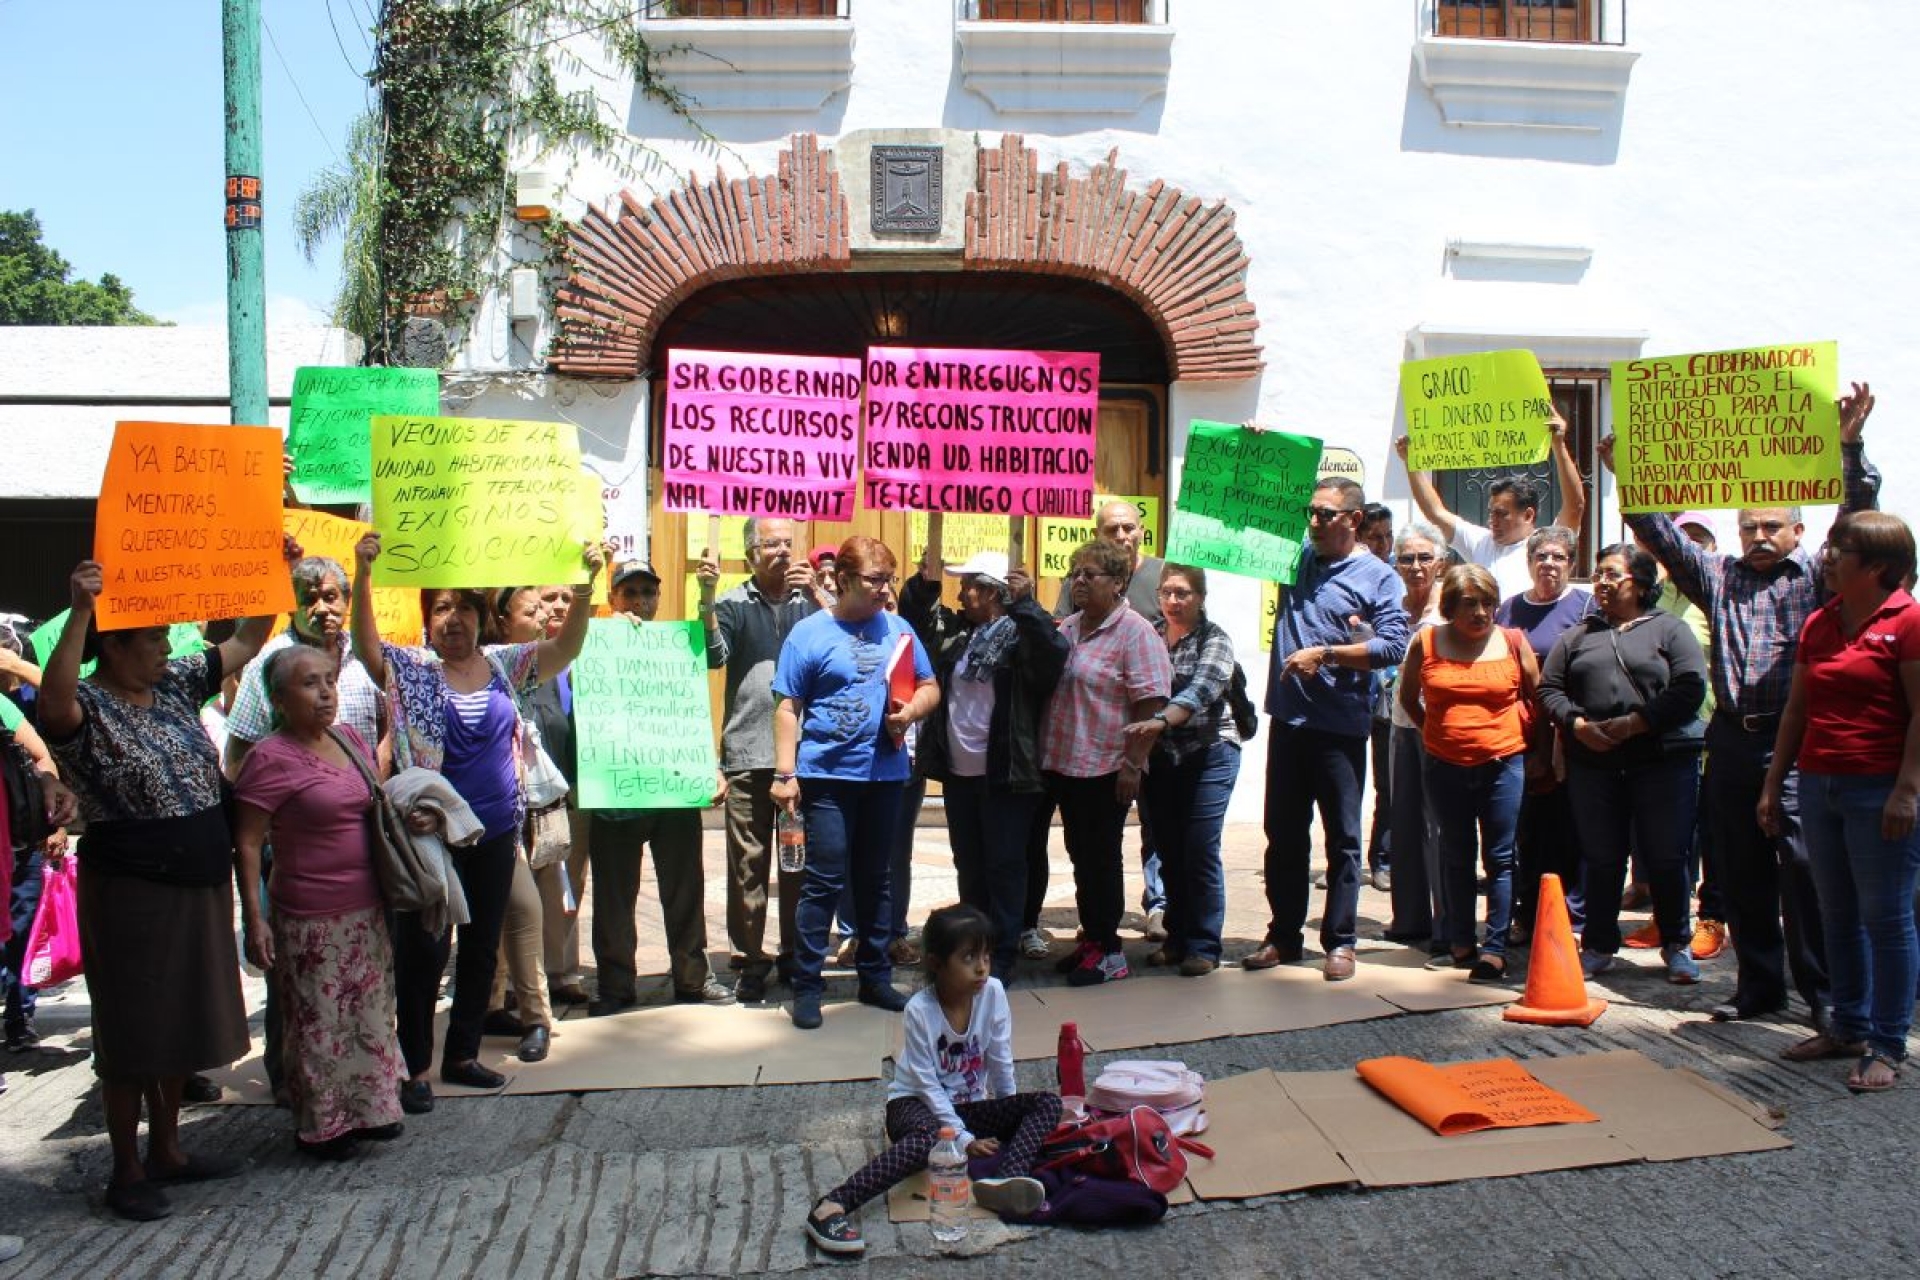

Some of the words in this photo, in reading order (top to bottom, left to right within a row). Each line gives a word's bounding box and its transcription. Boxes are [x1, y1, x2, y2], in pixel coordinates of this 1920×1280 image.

[868, 360, 898, 388] OR
[1627, 361, 1681, 381] SR.
[1688, 348, 1815, 377] GOBERNADOR
[1629, 373, 1761, 402] ENTREGUENOS
[1774, 370, 1804, 391] EL
[671, 402, 715, 432] LOS
[730, 405, 854, 440] RECURSOS
[1413, 407, 1429, 430] EL
[1442, 402, 1493, 428] DINERO
[1500, 401, 1515, 422] ES
[1629, 398, 1716, 423] RECURSO
[1732, 394, 1779, 415] PARA
[1788, 392, 1812, 413] LA
[391, 420, 475, 448] VECINOS
[483, 424, 517, 443] DE
[525, 426, 558, 445] LA
[1414, 434, 1427, 451] LA
[1472, 430, 1489, 449] NO
[1496, 430, 1527, 448] PARA
[1629, 415, 1805, 444] RECONSTRUCCION
[130, 442, 161, 474] YA
[174, 445, 228, 475] BASTA
[244, 450, 264, 476] DE
[669, 443, 697, 471] DE
[707, 445, 806, 478] NUESTRA
[817, 451, 855, 479] VIV
[867, 441, 931, 470] IENDA
[1629, 444, 1650, 464] DE
[1664, 439, 1750, 463] NUESTRA
[1760, 434, 1825, 457] UNIDAD
[375, 457, 436, 480] UNIDAD
[448, 453, 572, 475] HABITACIONAL
[1185, 457, 1221, 475] LOS
[1631, 461, 1750, 483] HABITACIONAL
[394, 481, 473, 503] INFONAVIT
[666, 481, 711, 510] NAL
[722, 485, 846, 516] INFONAVIT
[867, 481, 1012, 513] TETELCINGO
[1182, 479, 1214, 499] que
[1620, 482, 1713, 508] INFONAVIT
[396, 500, 560, 532] EXIGIMOS
[120, 528, 209, 553] QUEREMOS
[387, 523, 576, 573] SOLUCION
[115, 567, 126, 584] A
[134, 563, 202, 584] NUESTRAS
[109, 593, 186, 614] INFONAVIT
